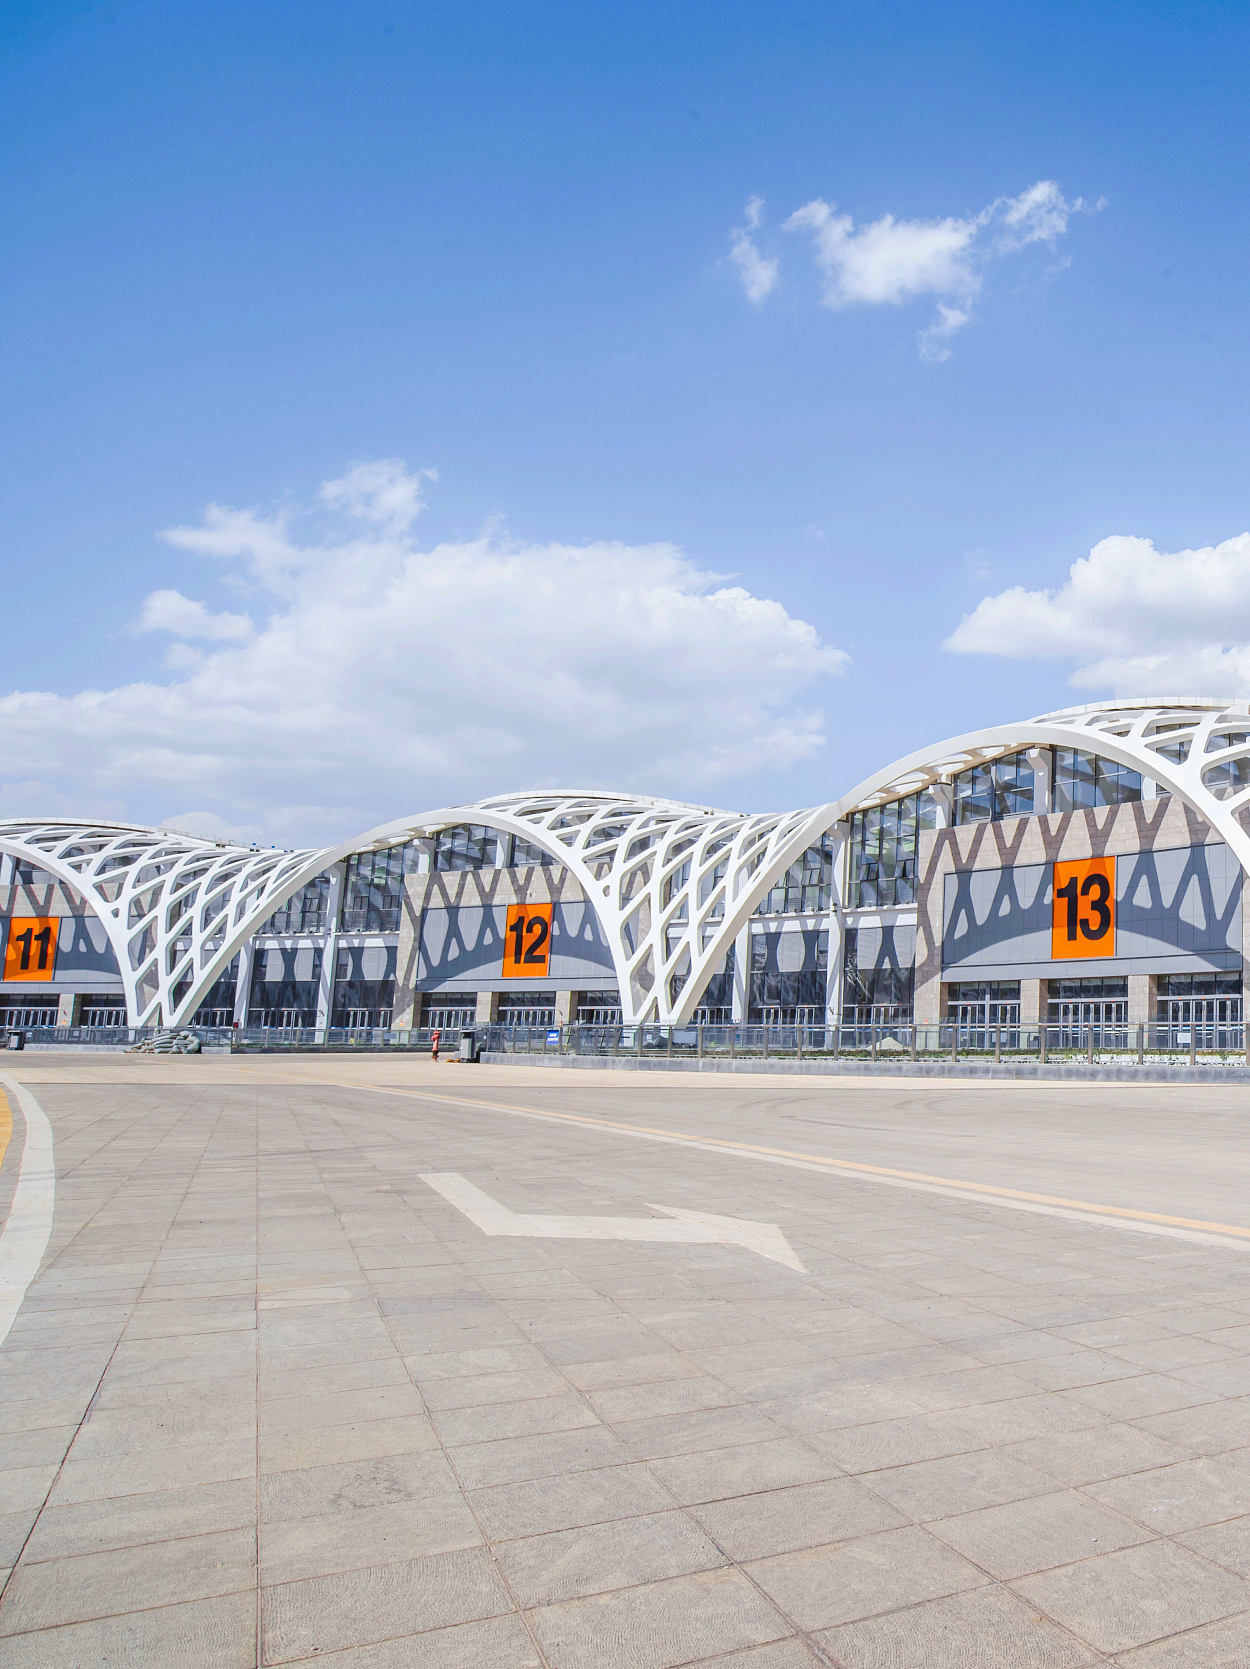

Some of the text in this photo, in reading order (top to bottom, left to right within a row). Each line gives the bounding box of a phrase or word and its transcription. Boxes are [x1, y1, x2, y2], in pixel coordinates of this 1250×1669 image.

[1056, 873, 1111, 941] 13
[16, 927, 51, 970] 11
[509, 916, 548, 964] 12
